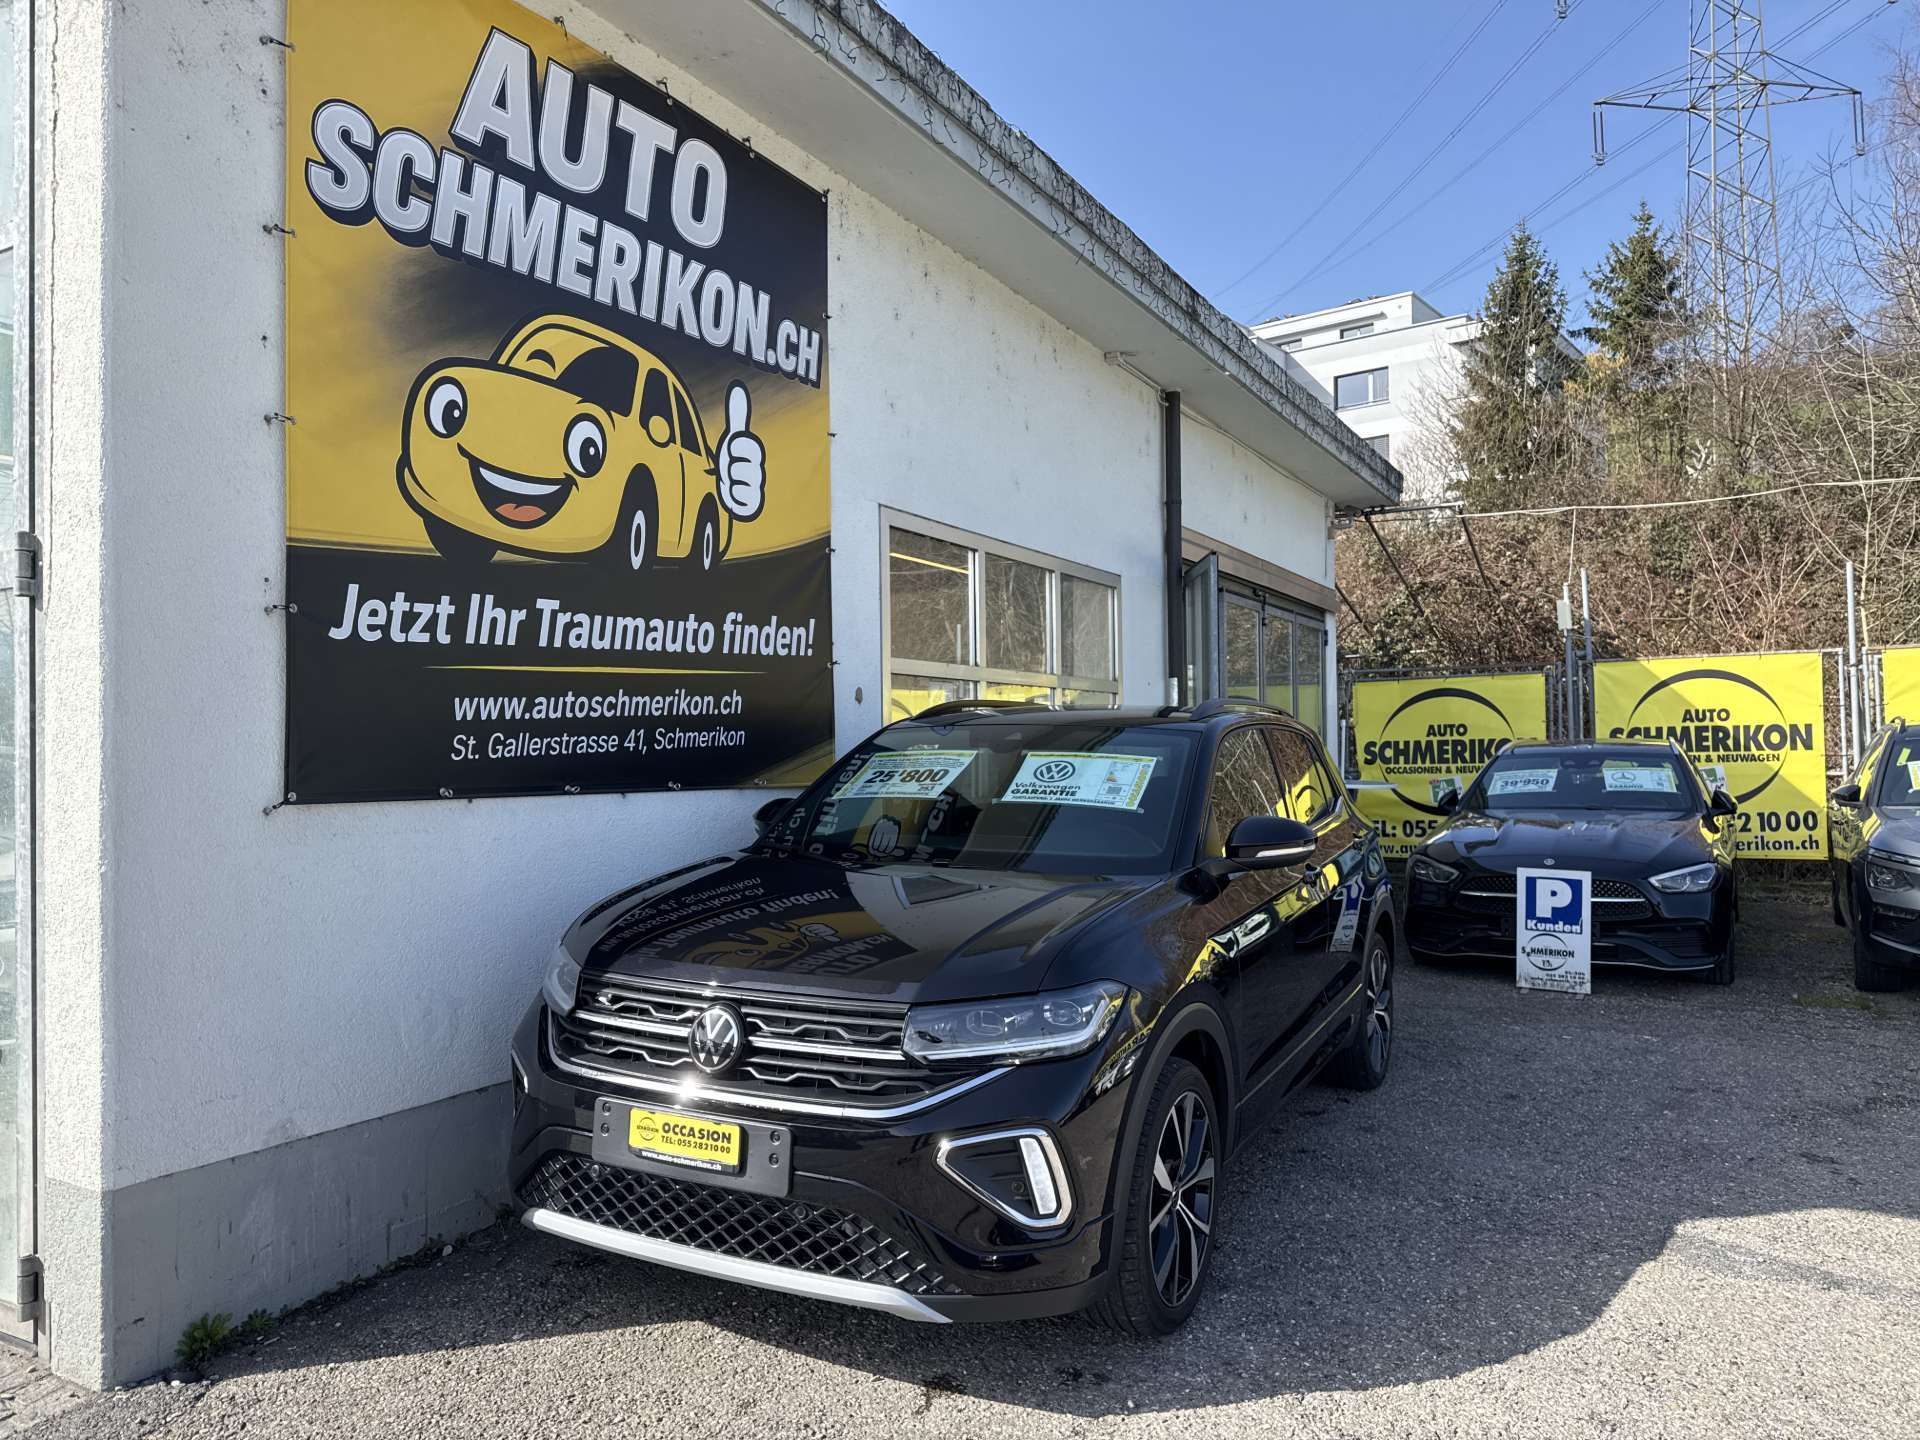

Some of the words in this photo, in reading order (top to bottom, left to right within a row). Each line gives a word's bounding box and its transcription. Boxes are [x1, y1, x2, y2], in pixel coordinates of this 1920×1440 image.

[453, 27, 728, 249] AUTO
[308, 100, 821, 382] SCHMERIKON.CH
[328, 583, 455, 644] Jetzt
[465, 593, 527, 646] Ihr
[535, 598, 715, 654] Traumauto
[722, 611, 816, 656] finden!
[454, 689, 742, 721] www.autoschmerikon.ch
[1681, 708, 1731, 723] AUTO
[1426, 723, 1468, 738] AUTO
[450, 734, 480, 761] St.
[488, 732, 619, 759] Gallerstrasse
[623, 728, 648, 755] 41,
[653, 726, 746, 750] Schmerikon
[1364, 737, 1536, 766] SCHMERIK
[1704, 753, 1714, 764] &
[1717, 753, 1780, 763] NEUWAGEN
[863, 768, 950, 784] 25'800
[1385, 765, 1442, 775] OCCASIONEN
[1445, 765, 1453, 775] &
[1010, 788, 1079, 797] GARANTIE
[1015, 782, 1081, 791] Volkswagen
[1756, 811, 1781, 832] 10
[1785, 810, 1819, 832] 00
[1736, 833, 1820, 851] erikon.ch
[1535, 878, 1573, 918] P
[1526, 918, 1582, 934] Kunden
[661, 1135, 676, 1145] TEL:
[662, 1122, 732, 1145] OCCASION
